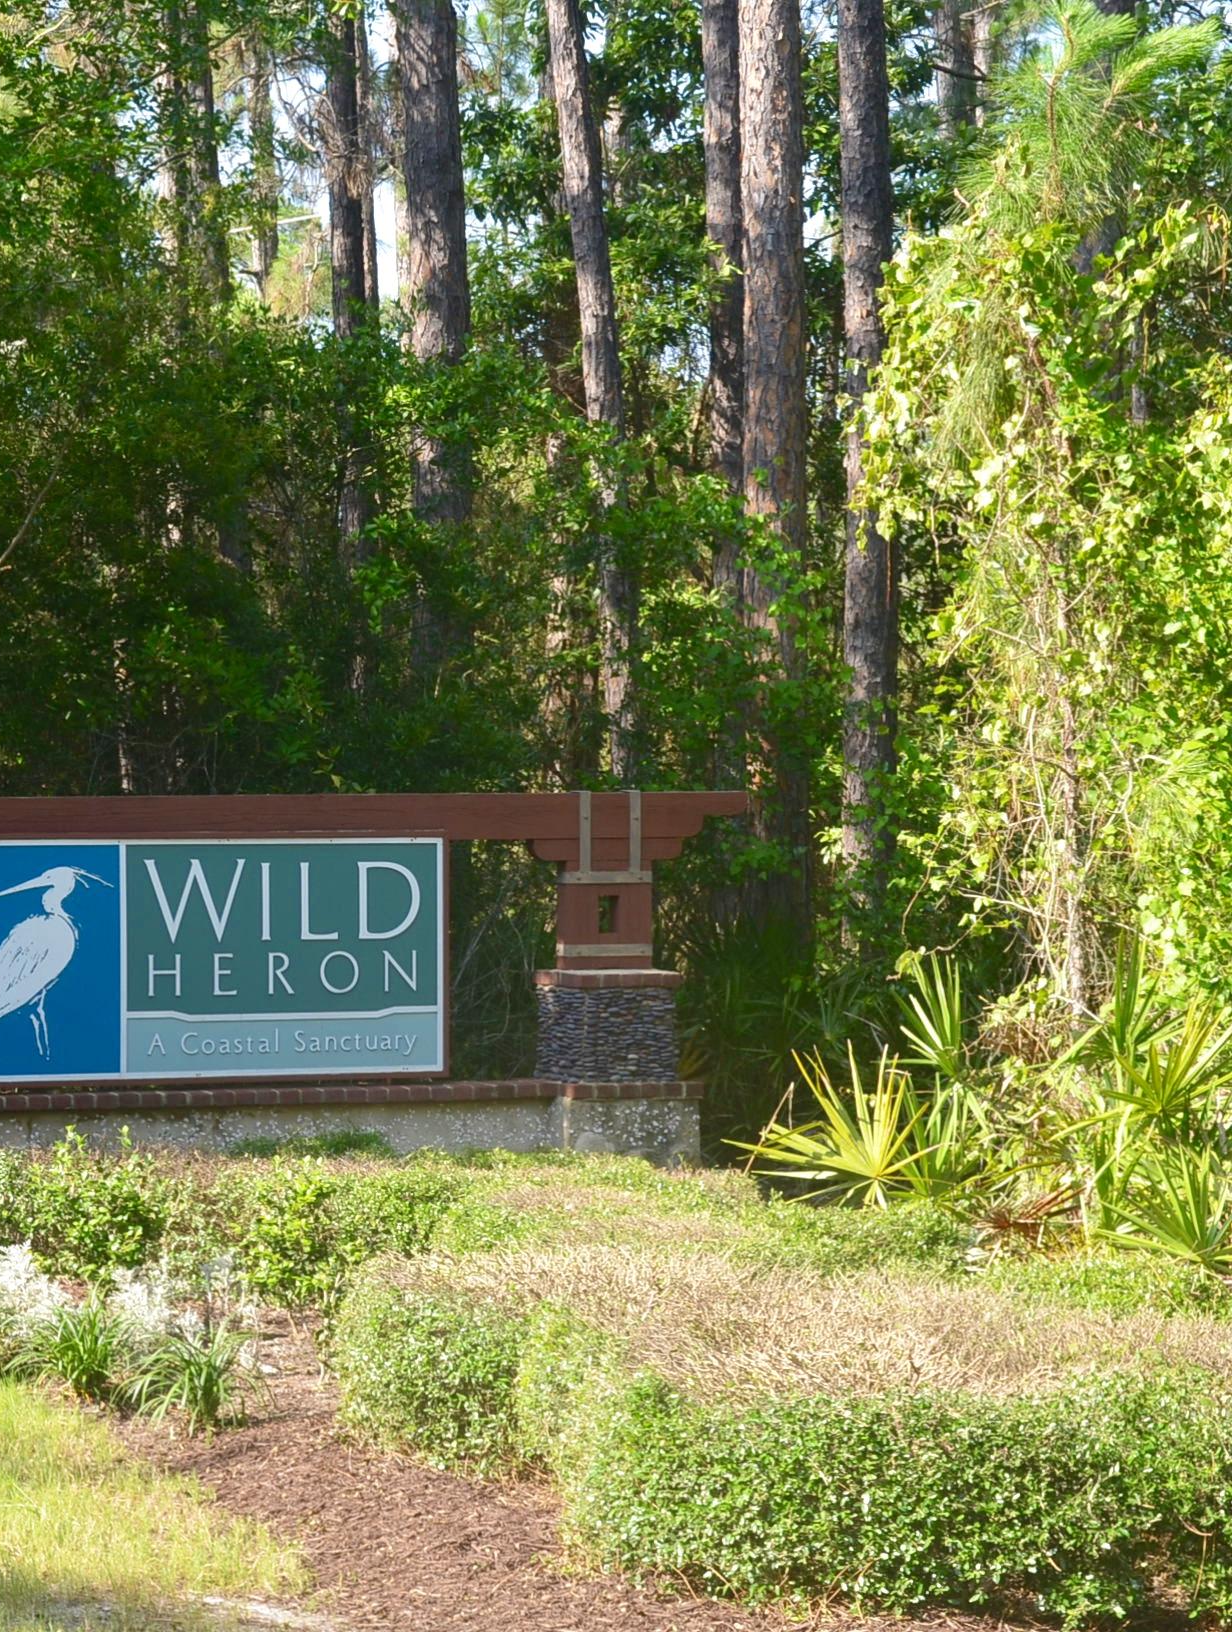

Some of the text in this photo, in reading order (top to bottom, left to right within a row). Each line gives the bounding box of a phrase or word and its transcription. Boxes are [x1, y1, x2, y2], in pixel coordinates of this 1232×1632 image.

[144, 858, 422, 944] WILD
[147, 950, 418, 997] HERON
[147, 1028, 418, 1056] A Coastal Sanctuary
